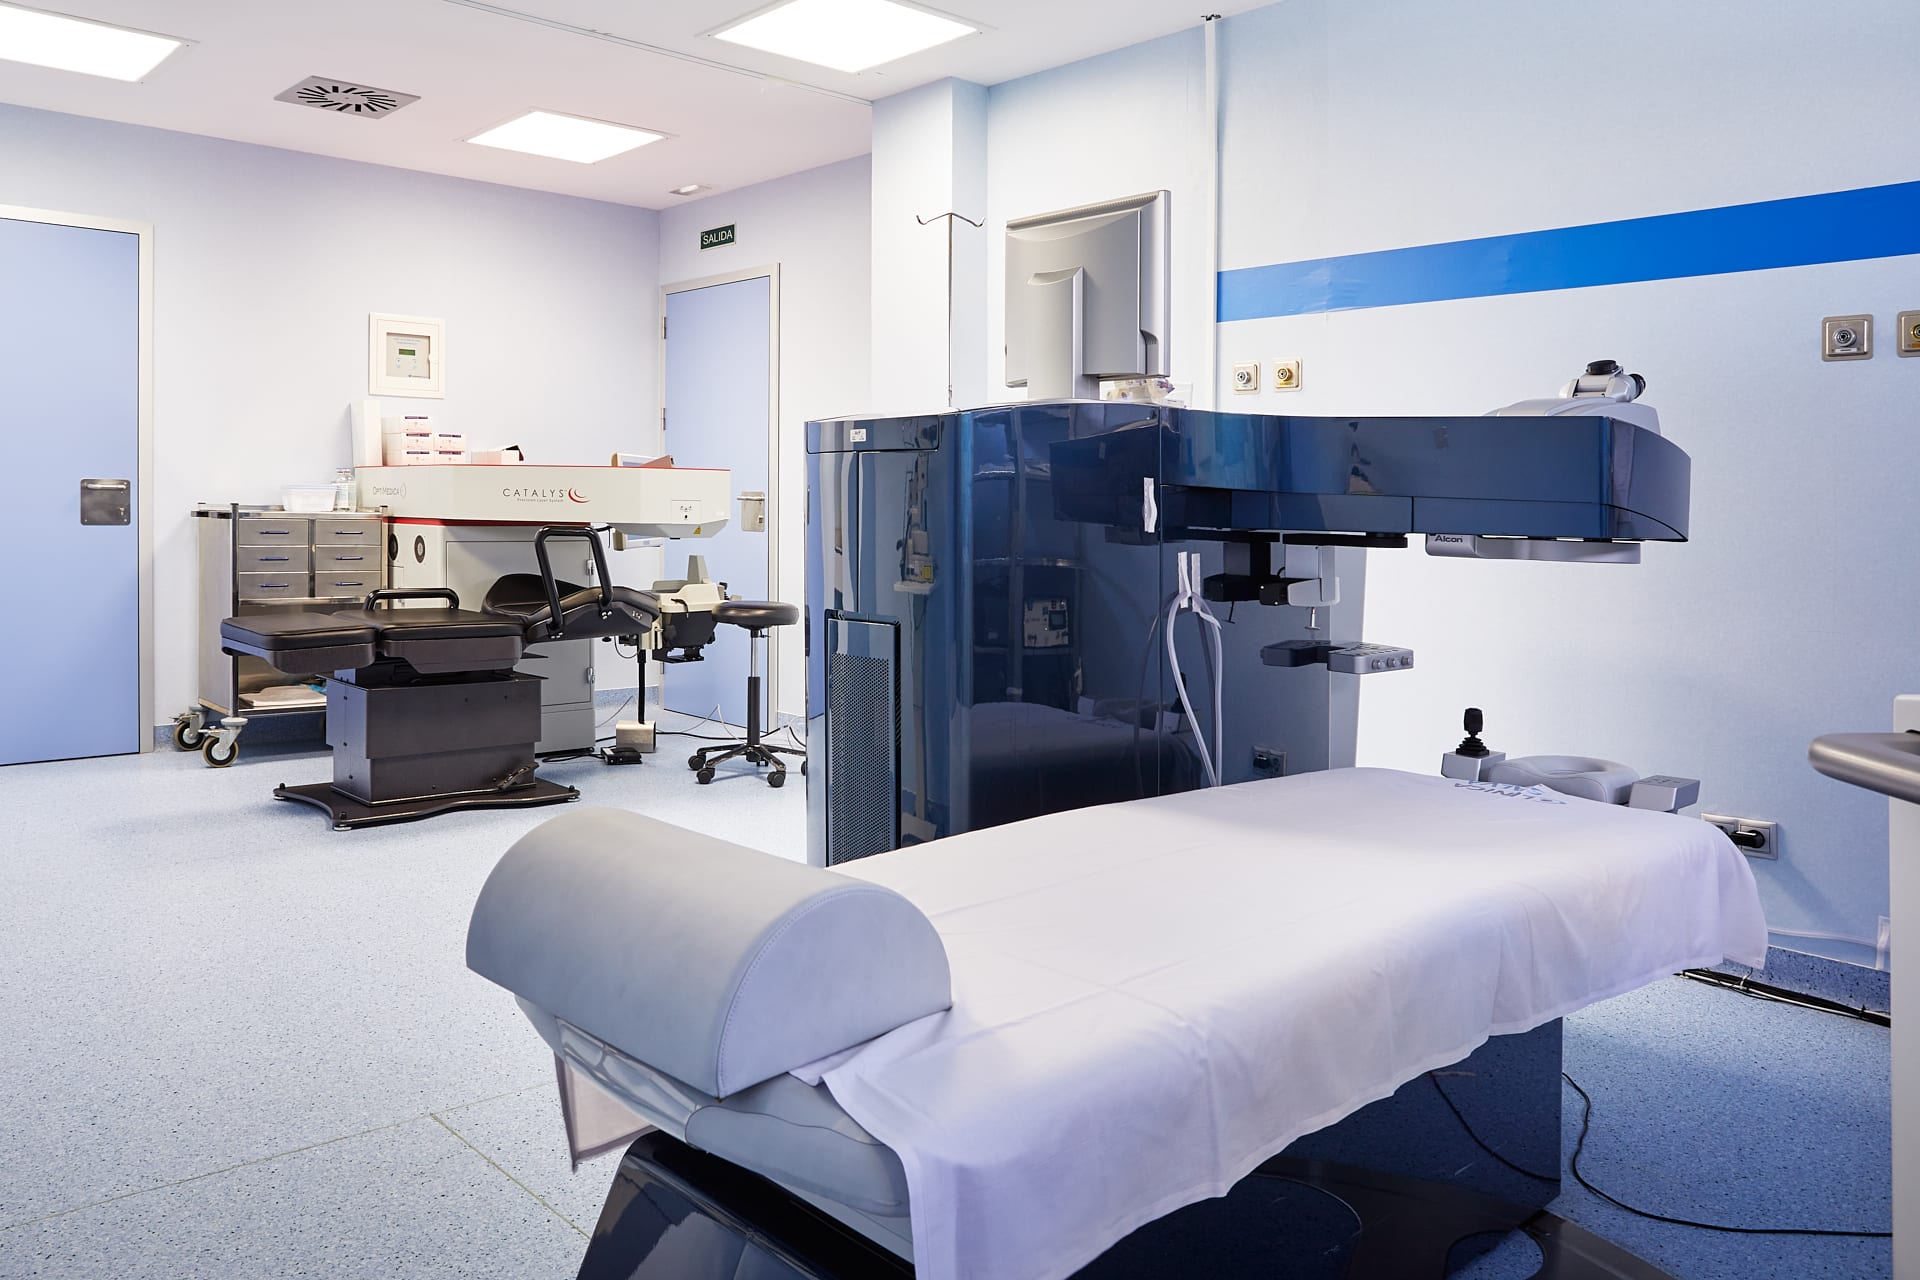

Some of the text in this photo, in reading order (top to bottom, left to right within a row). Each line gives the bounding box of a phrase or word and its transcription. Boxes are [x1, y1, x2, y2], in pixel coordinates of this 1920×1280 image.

[703, 230, 733, 245] SALIDA
[502, 488, 564, 498] CATALYS
[1435, 535, 1463, 543] Alcon
